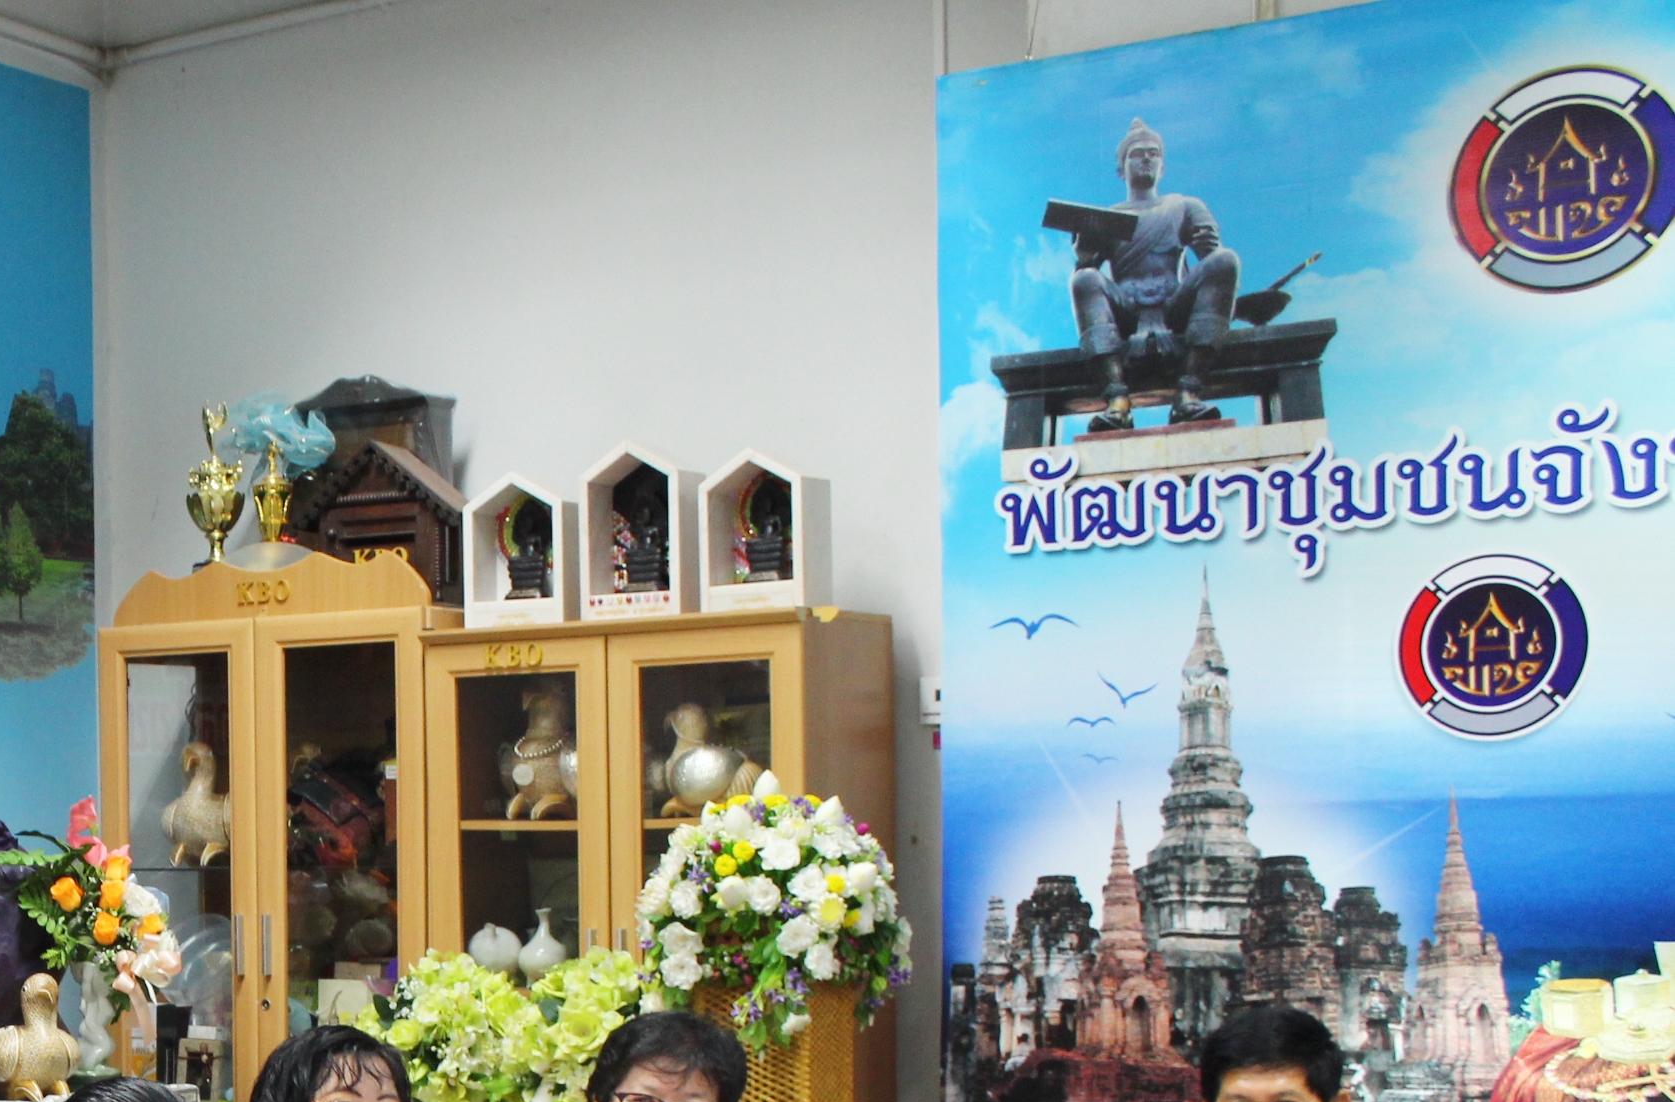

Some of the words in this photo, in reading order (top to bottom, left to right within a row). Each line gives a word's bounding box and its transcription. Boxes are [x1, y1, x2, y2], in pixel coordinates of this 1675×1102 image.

[1001, 406, 1675, 570] พัฒนาชุมชนจัง
[237, 580, 291, 606] KBO
[484, 642, 543, 668] KBO
